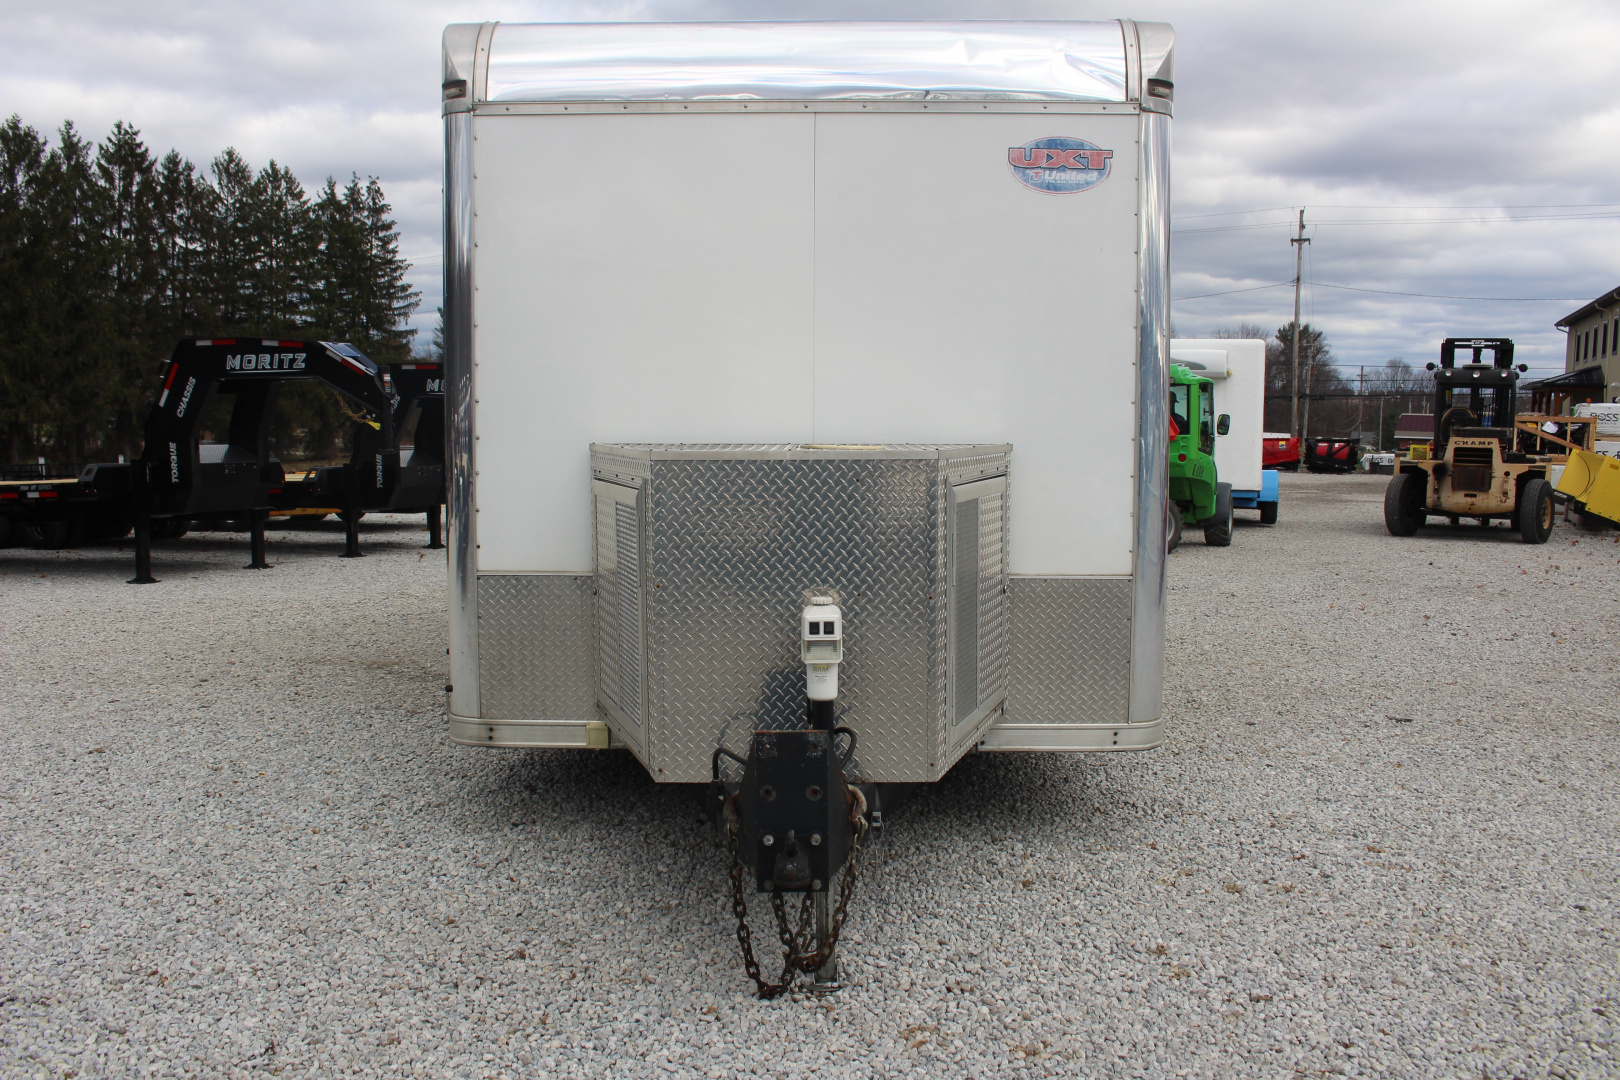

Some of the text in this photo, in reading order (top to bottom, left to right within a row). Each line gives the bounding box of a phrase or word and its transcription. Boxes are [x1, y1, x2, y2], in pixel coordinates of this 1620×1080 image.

[1008, 147, 1113, 170] UXT
[1044, 170, 1098, 181] United
[226, 353, 306, 370] MORITZ
[176, 376, 196, 418] CHASSIS
[169, 442, 179, 483] TORQUE
